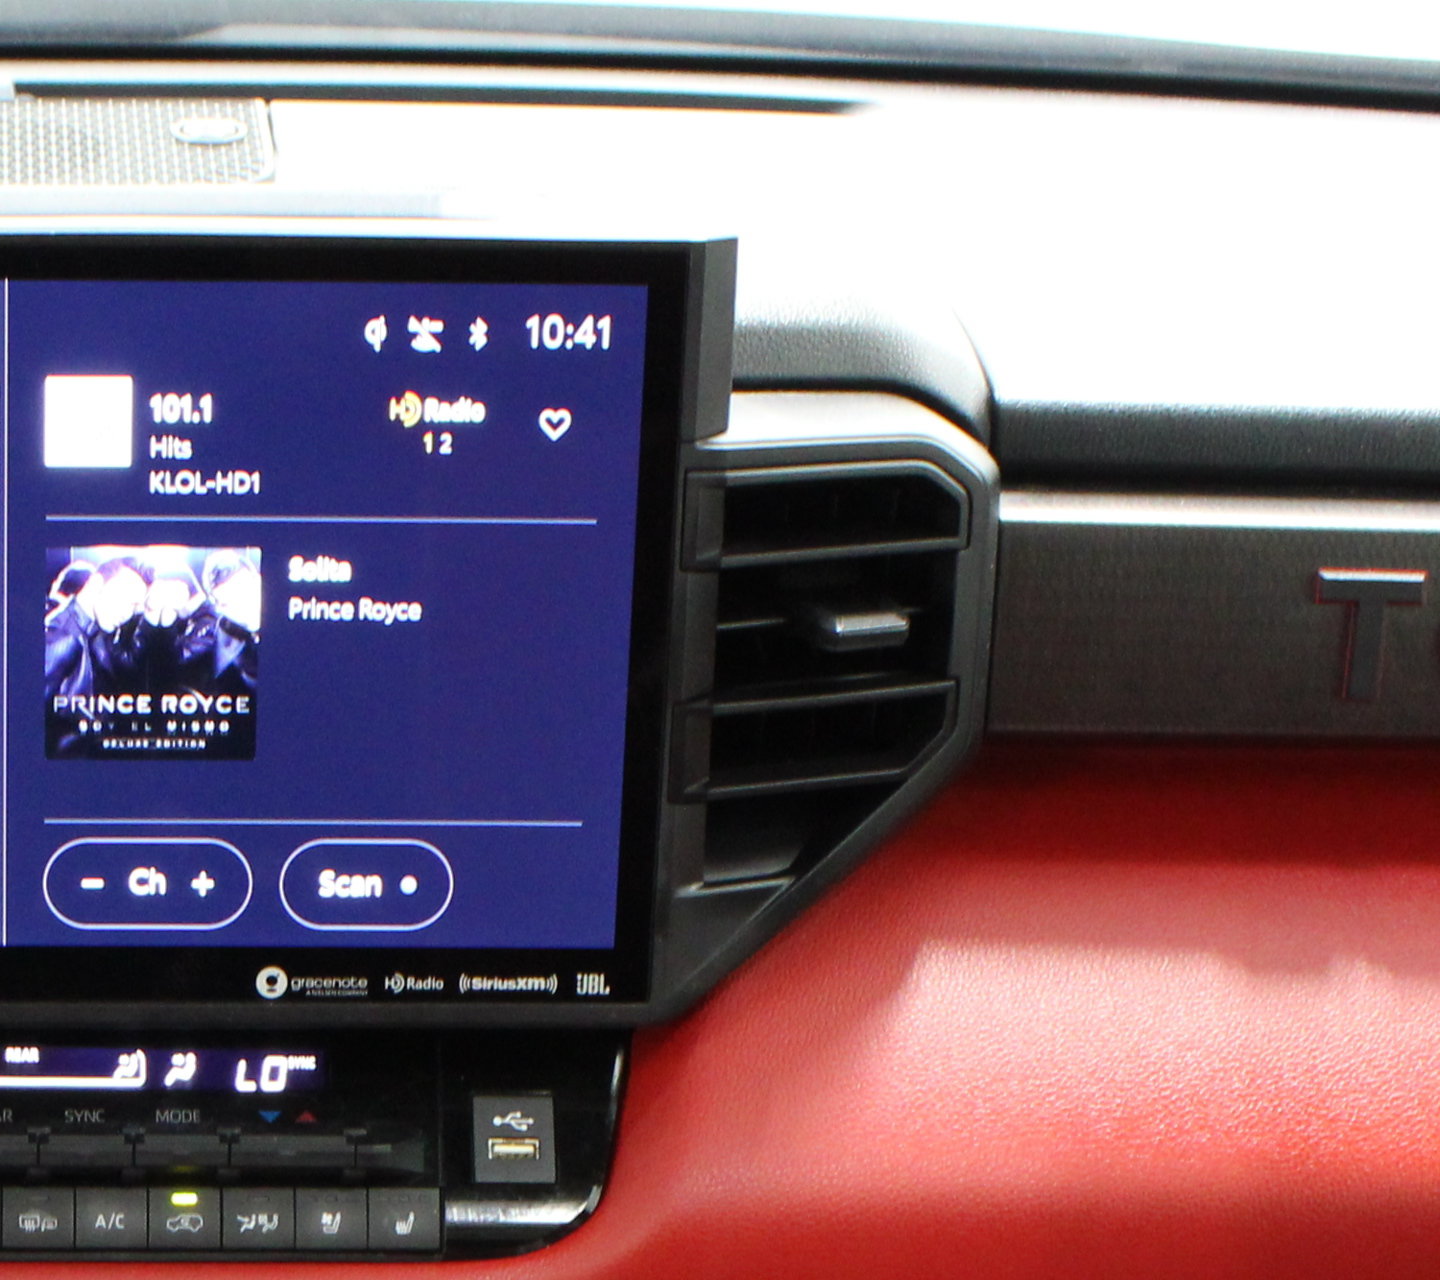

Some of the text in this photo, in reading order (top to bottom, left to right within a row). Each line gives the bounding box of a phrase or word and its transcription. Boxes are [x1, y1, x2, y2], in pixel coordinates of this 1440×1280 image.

[524, 314, 612, 352] 10:41
[149, 393, 214, 424] 101.1
[423, 395, 486, 425] Radio
[149, 436, 193, 460] Hits
[149, 471, 261, 496] KLOL-HD1
[287, 555, 352, 584] Solita
[288, 597, 423, 626] Prince Royce
[53, 694, 251, 719] PRINCE ROYCE
[127, 866, 167, 896] Ch
[317, 867, 383, 899] Scan
[290, 977, 369, 992] gracenote
[406, 976, 445, 991] Radio
[4, 1046, 40, 1064] REAR
[64, 1108, 106, 1125] SYNC
[155, 1108, 202, 1124] MODE
[95, 1212, 126, 1231] A/C
